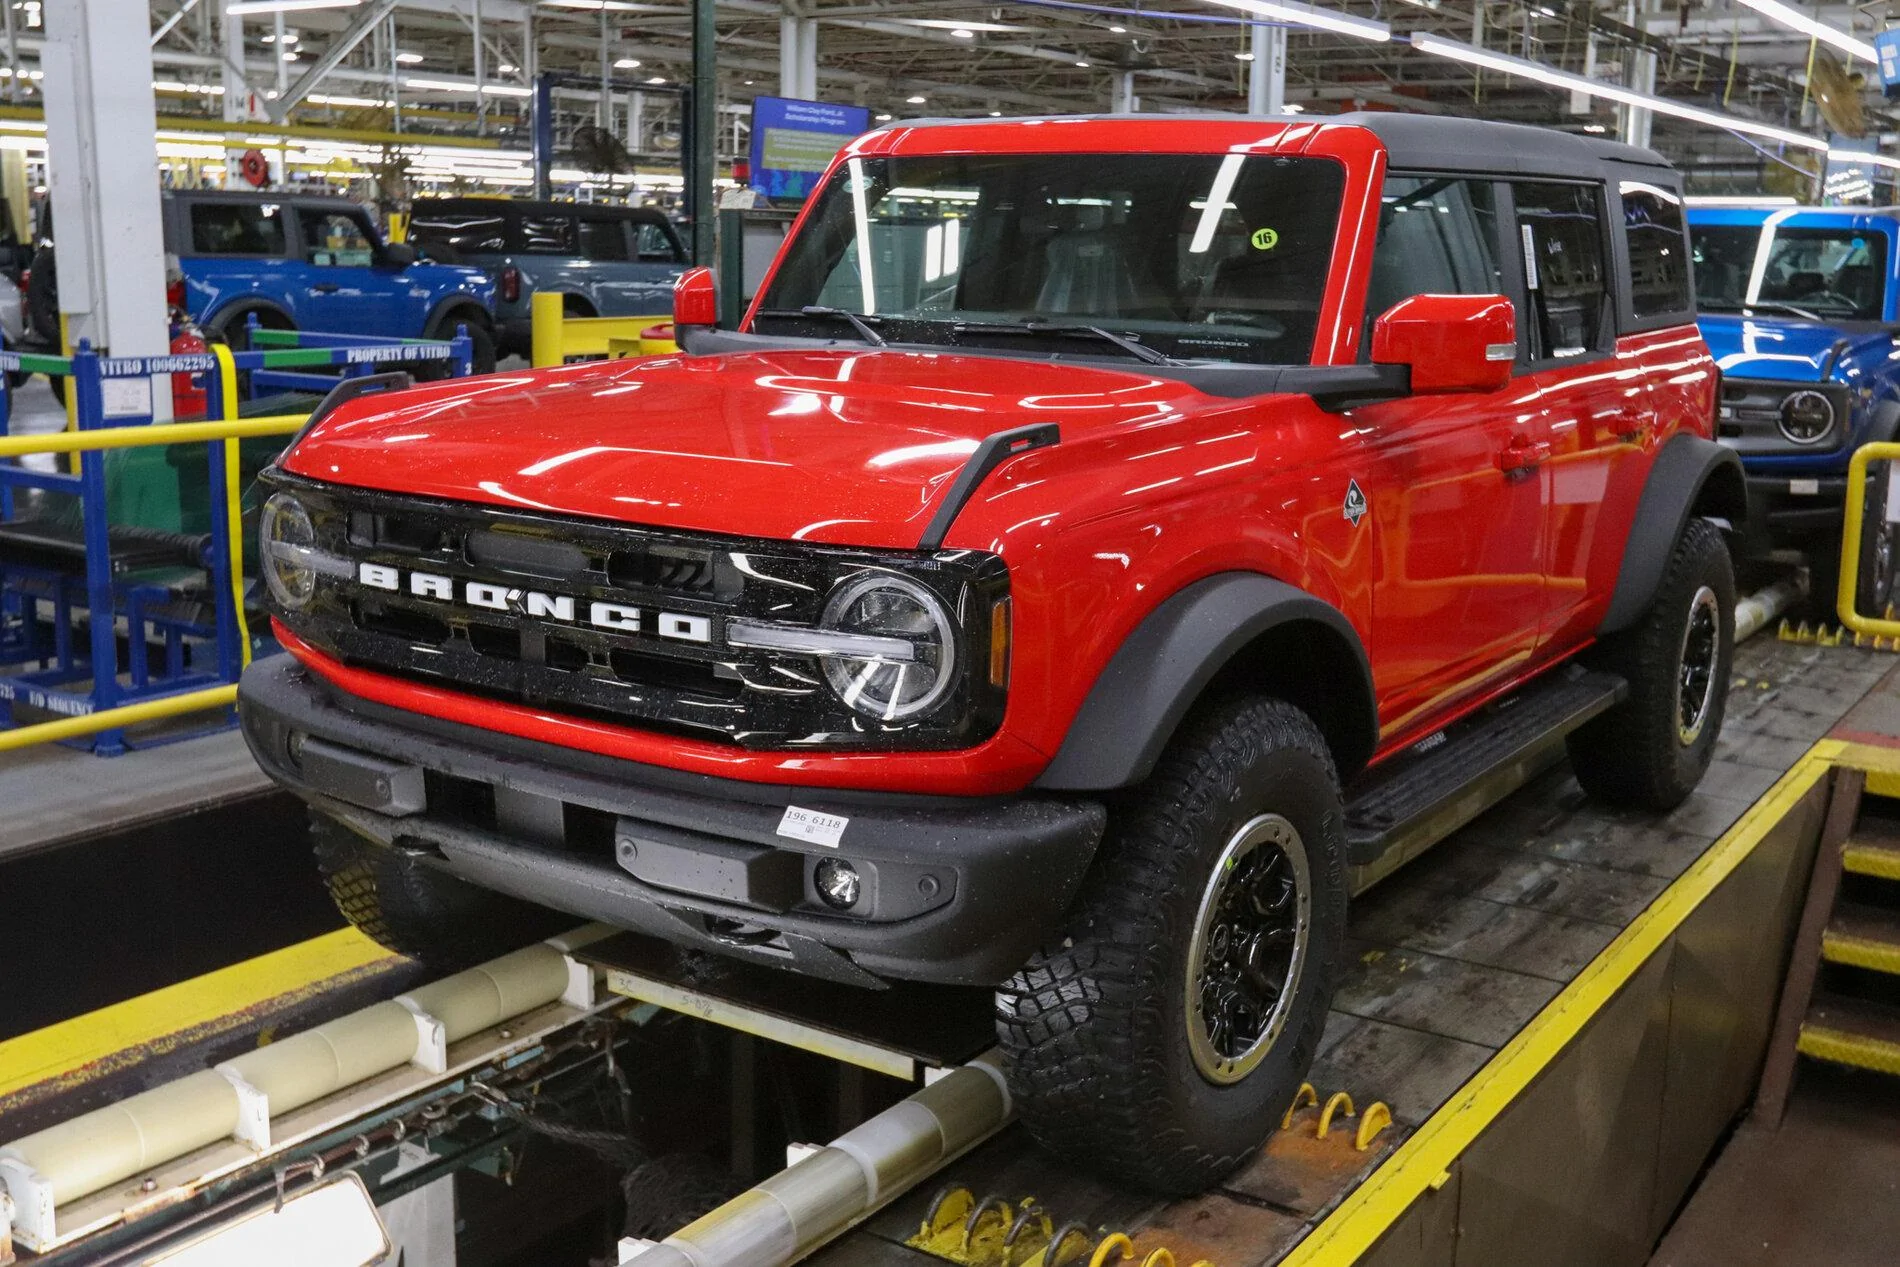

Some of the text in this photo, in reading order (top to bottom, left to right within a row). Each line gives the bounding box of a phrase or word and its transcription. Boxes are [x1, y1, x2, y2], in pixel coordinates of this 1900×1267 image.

[1255, 231, 1273, 246] 16
[347, 345, 451, 363] PROPERTY OF VITRO
[100, 359, 142, 376] VITRO
[359, 562, 711, 642] BRONCO
[786, 811, 841, 829] 196 6118
